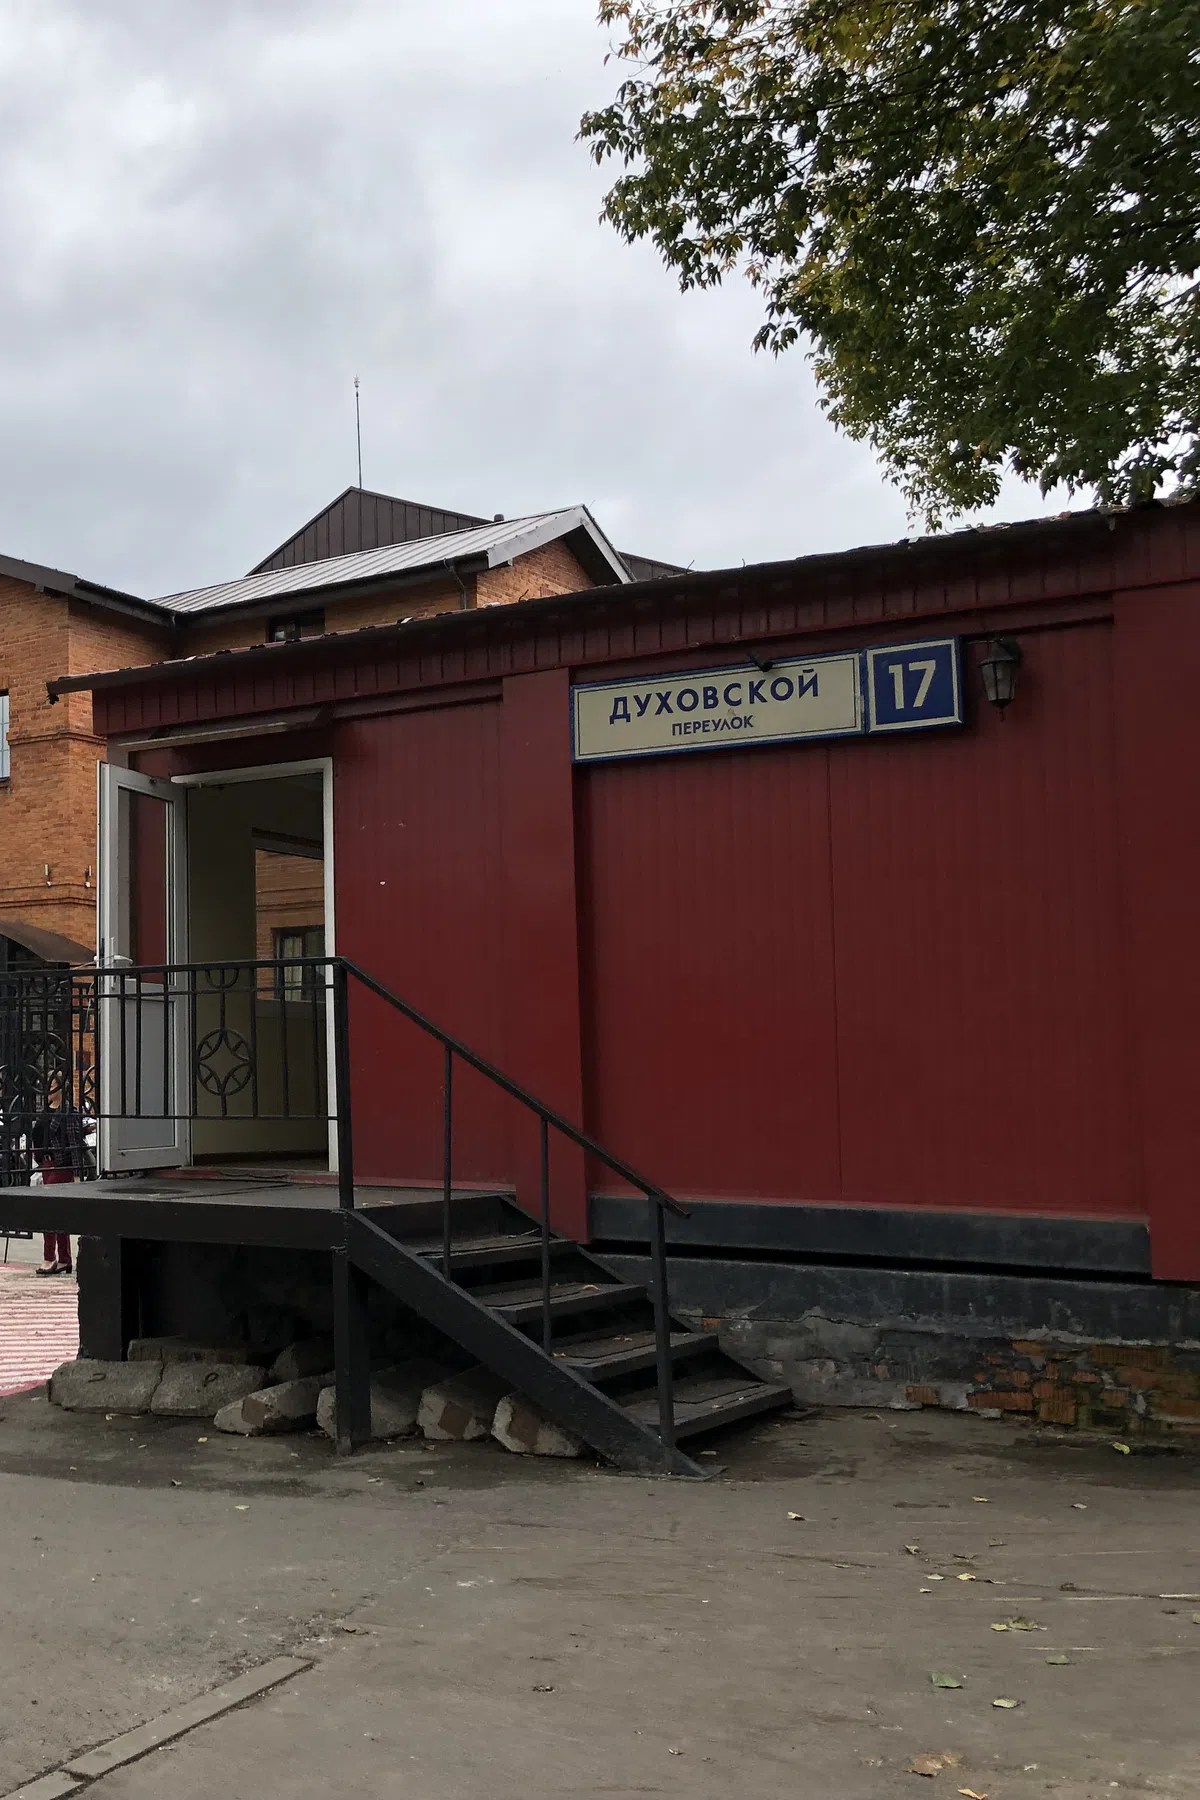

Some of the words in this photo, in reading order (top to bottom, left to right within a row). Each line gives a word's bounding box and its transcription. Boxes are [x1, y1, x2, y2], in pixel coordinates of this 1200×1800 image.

[609, 668, 819, 724] ДУХОВСКОЙ
[887, 659, 937, 710] 17
[671, 715, 755, 737] ПЕРЕУЛОК
